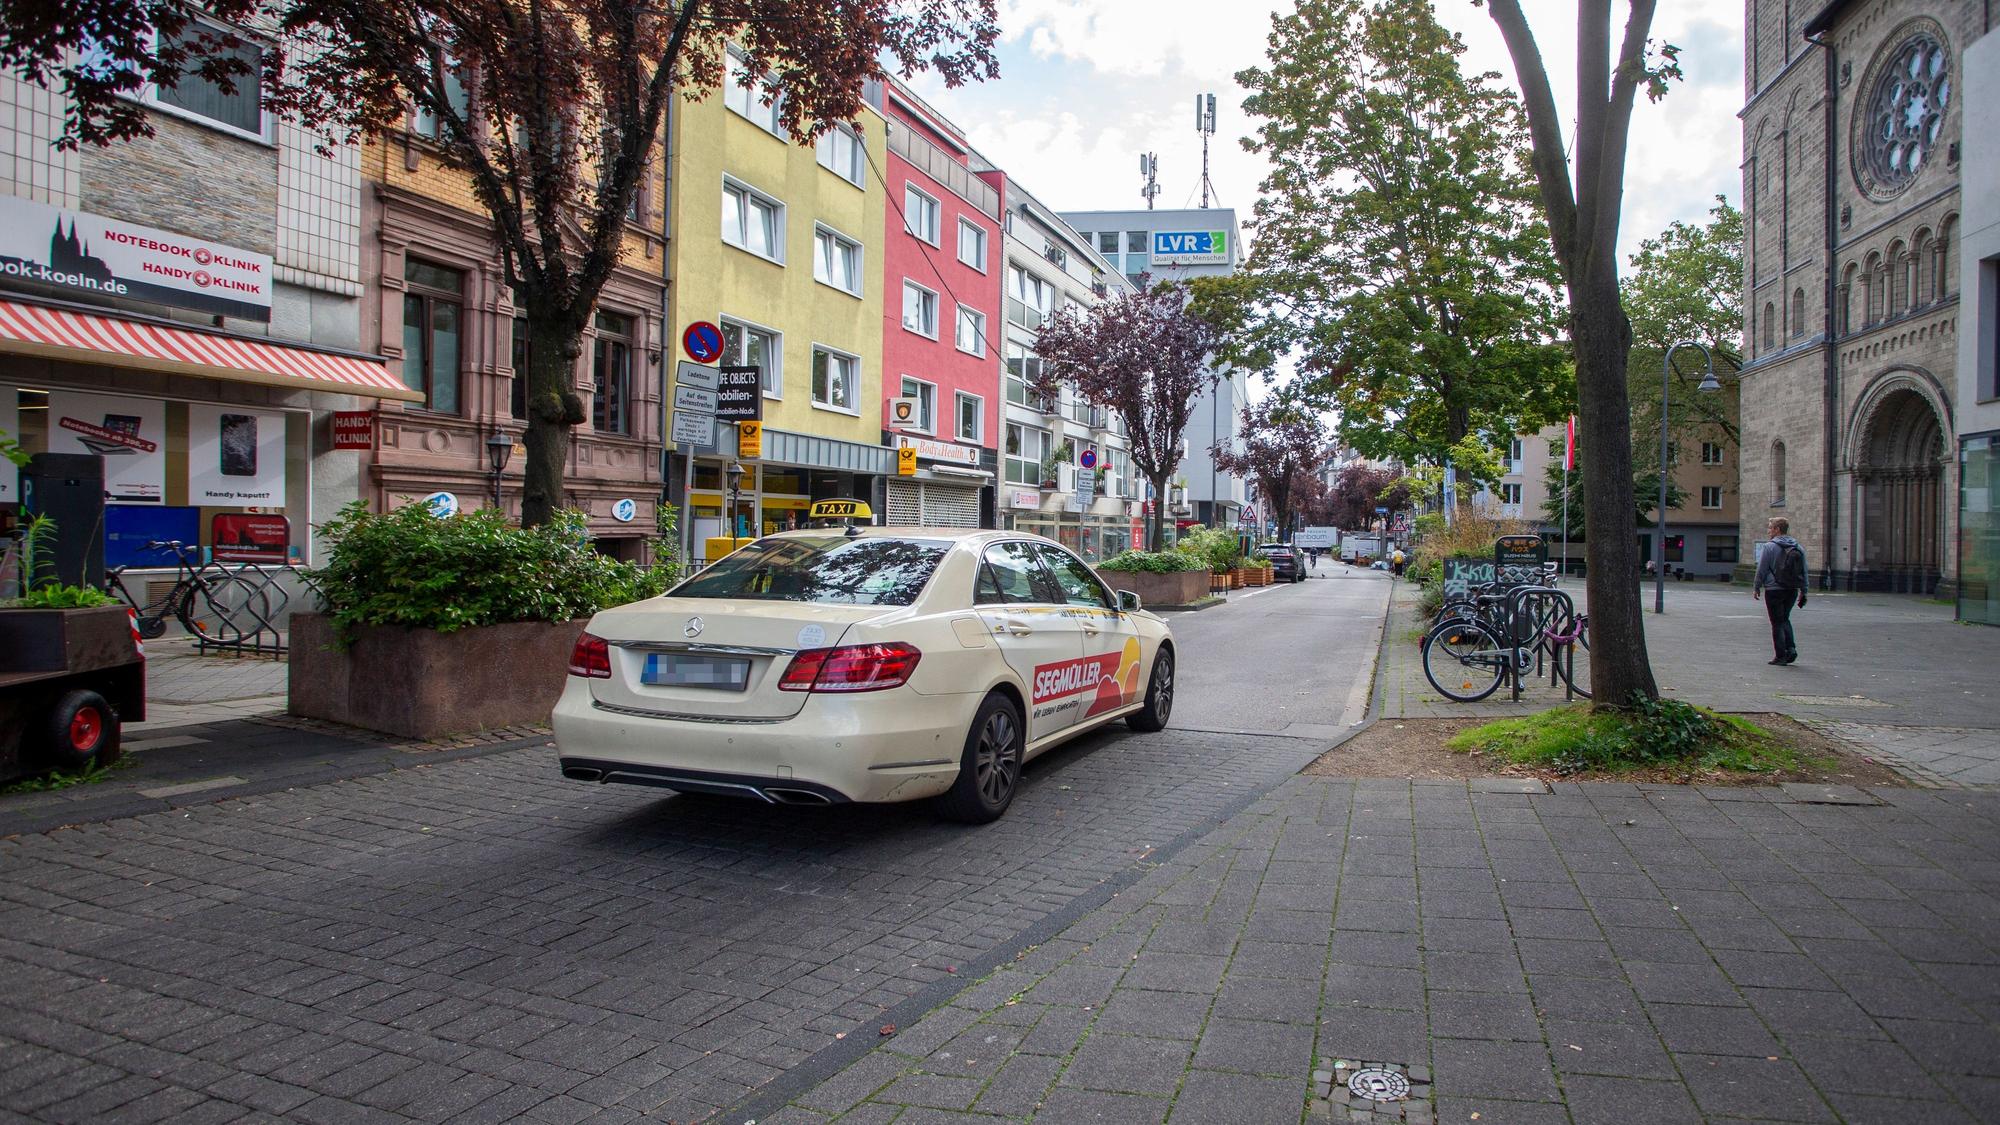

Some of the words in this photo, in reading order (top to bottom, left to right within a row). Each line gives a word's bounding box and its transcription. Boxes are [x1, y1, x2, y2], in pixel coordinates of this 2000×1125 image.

[1158, 235, 1198, 251] LVR
[105, 230, 191, 258] NOTEBOOK
[213, 255, 261, 273] KLINIK
[143, 262, 192, 280] HANDY
[213, 277, 260, 294] KLINIK
[729, 372, 756, 384] OBJECTS
[335, 417, 372, 428] HANDY
[335, 433, 371, 444] KLINIK
[920, 441, 937, 457] Body
[940, 444, 964, 459] Health
[206, 491, 234, 499] Handy
[237, 491, 270, 499] kaputt?
[821, 504, 851, 514] TAXI
[1034, 661, 1101, 699] SEGMÜLLER
